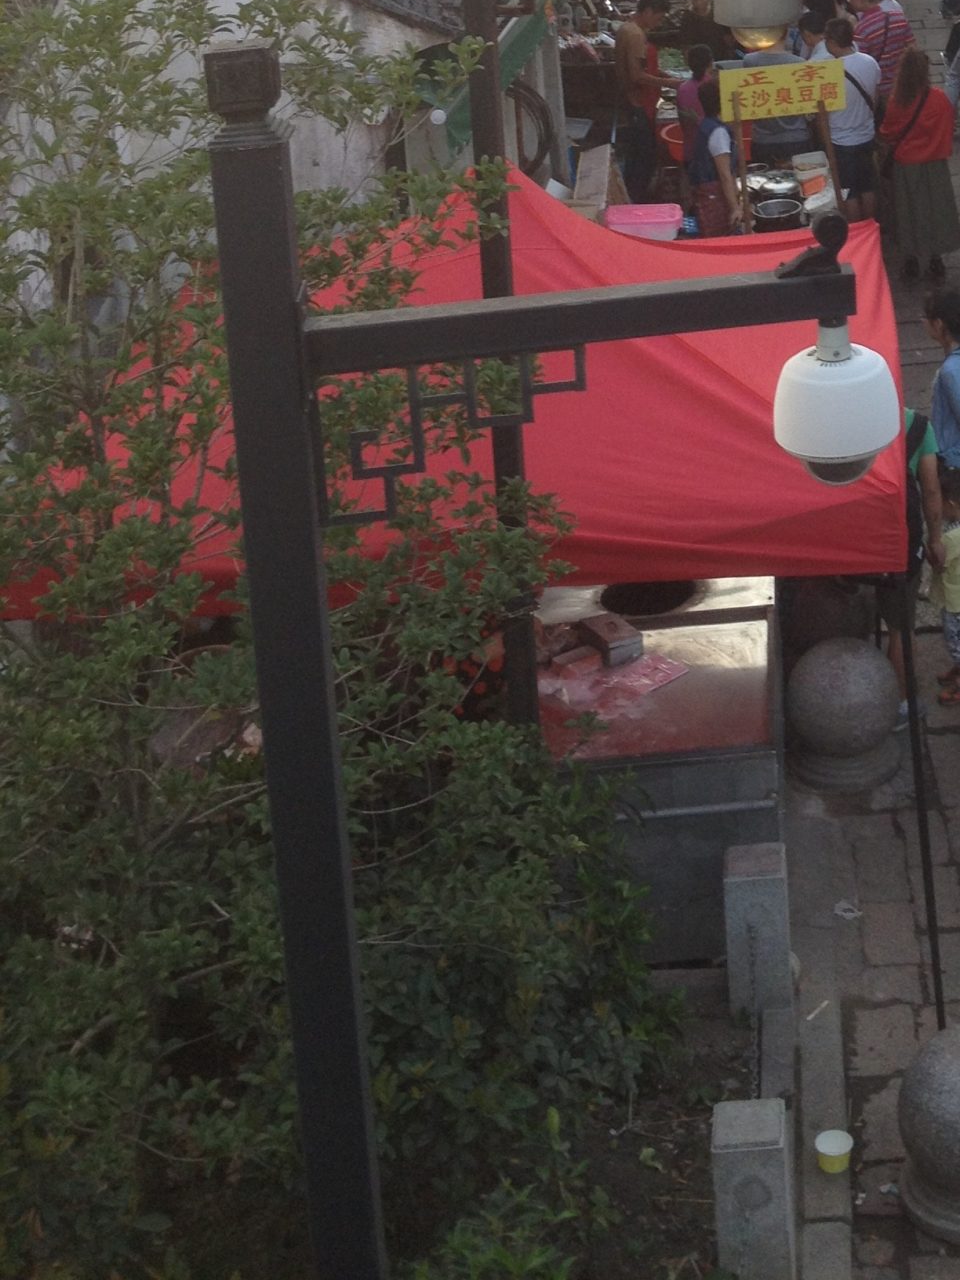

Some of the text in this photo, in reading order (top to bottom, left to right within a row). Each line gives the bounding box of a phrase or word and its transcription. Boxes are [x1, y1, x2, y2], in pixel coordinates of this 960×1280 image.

[738, 65, 827, 88] 正宗
[728, 82, 839, 108] 长沙臭豆腐
